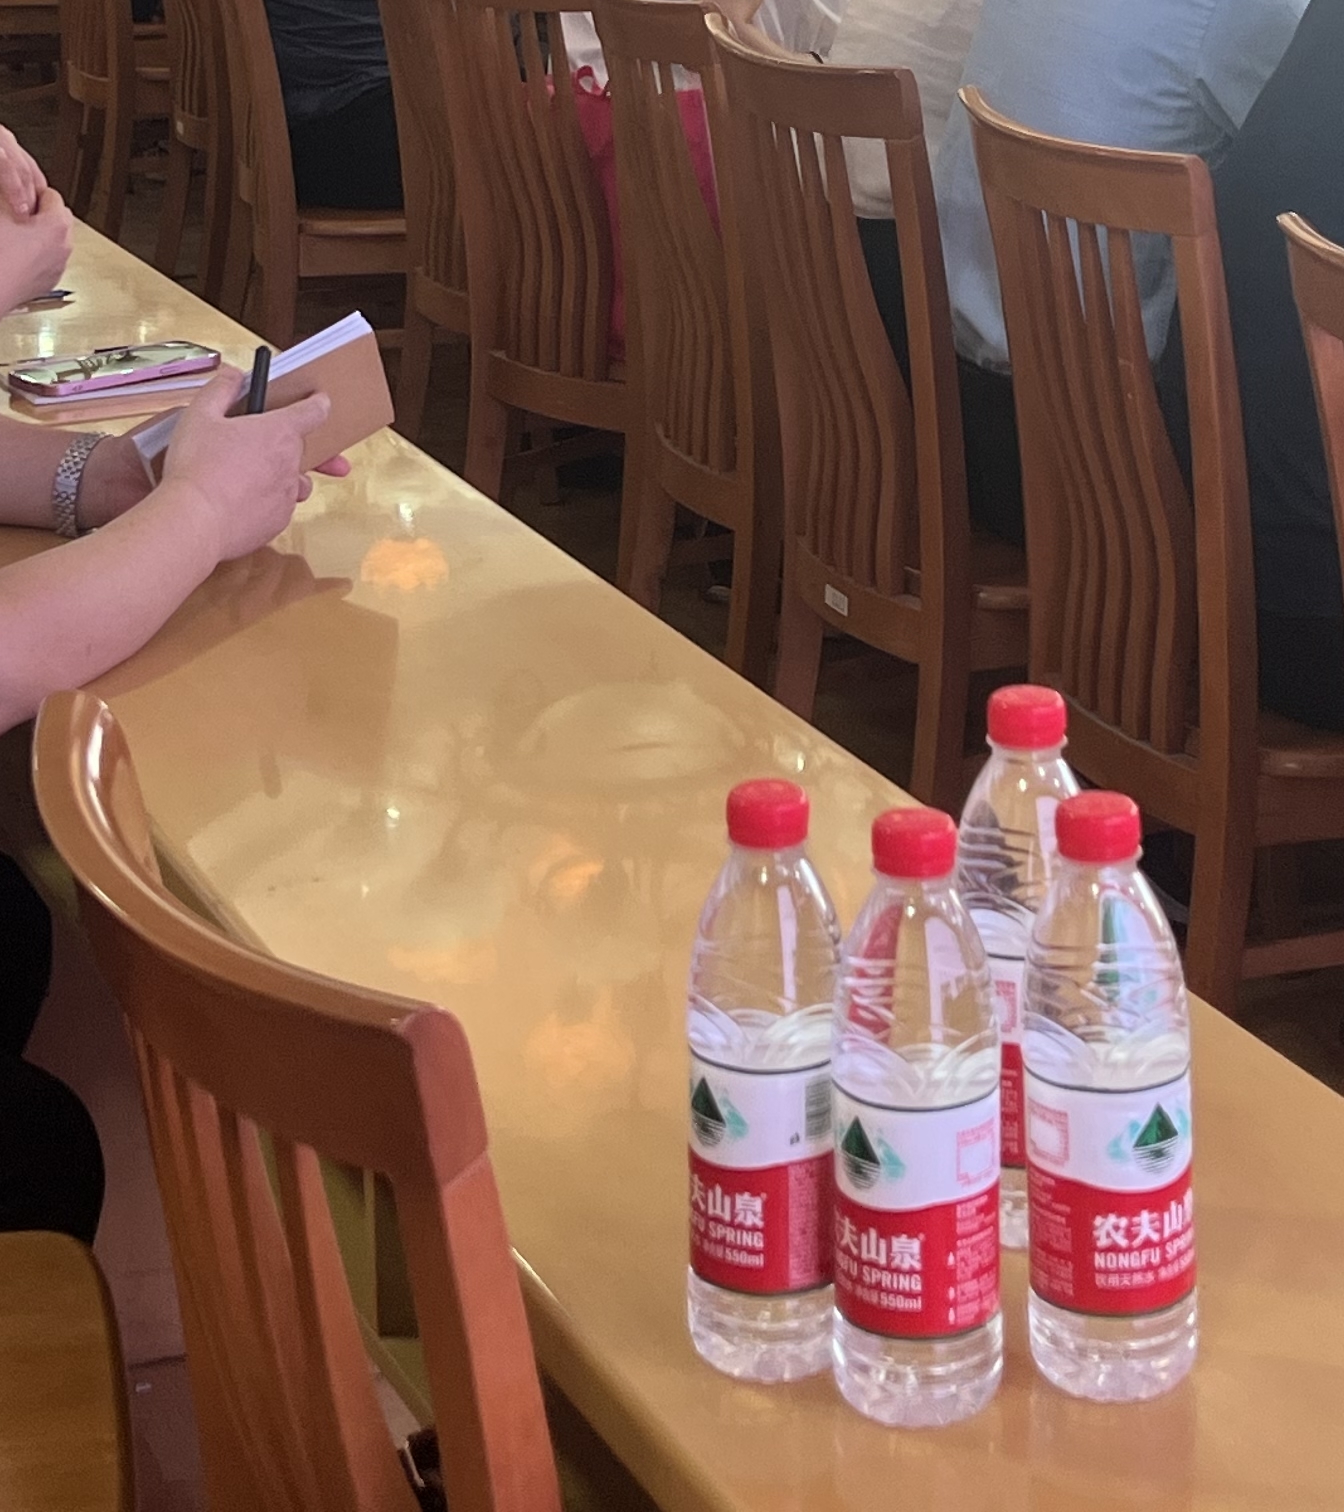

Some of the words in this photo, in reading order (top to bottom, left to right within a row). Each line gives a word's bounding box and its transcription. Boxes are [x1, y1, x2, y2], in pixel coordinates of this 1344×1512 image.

[709, 1220, 764, 1251] SPRING
[835, 1208, 922, 1272] 夫山泉
[1094, 1247, 1160, 1270] NONGFU
[862, 1264, 922, 1293] SPRING
[880, 1291, 922, 1311] 550ml
